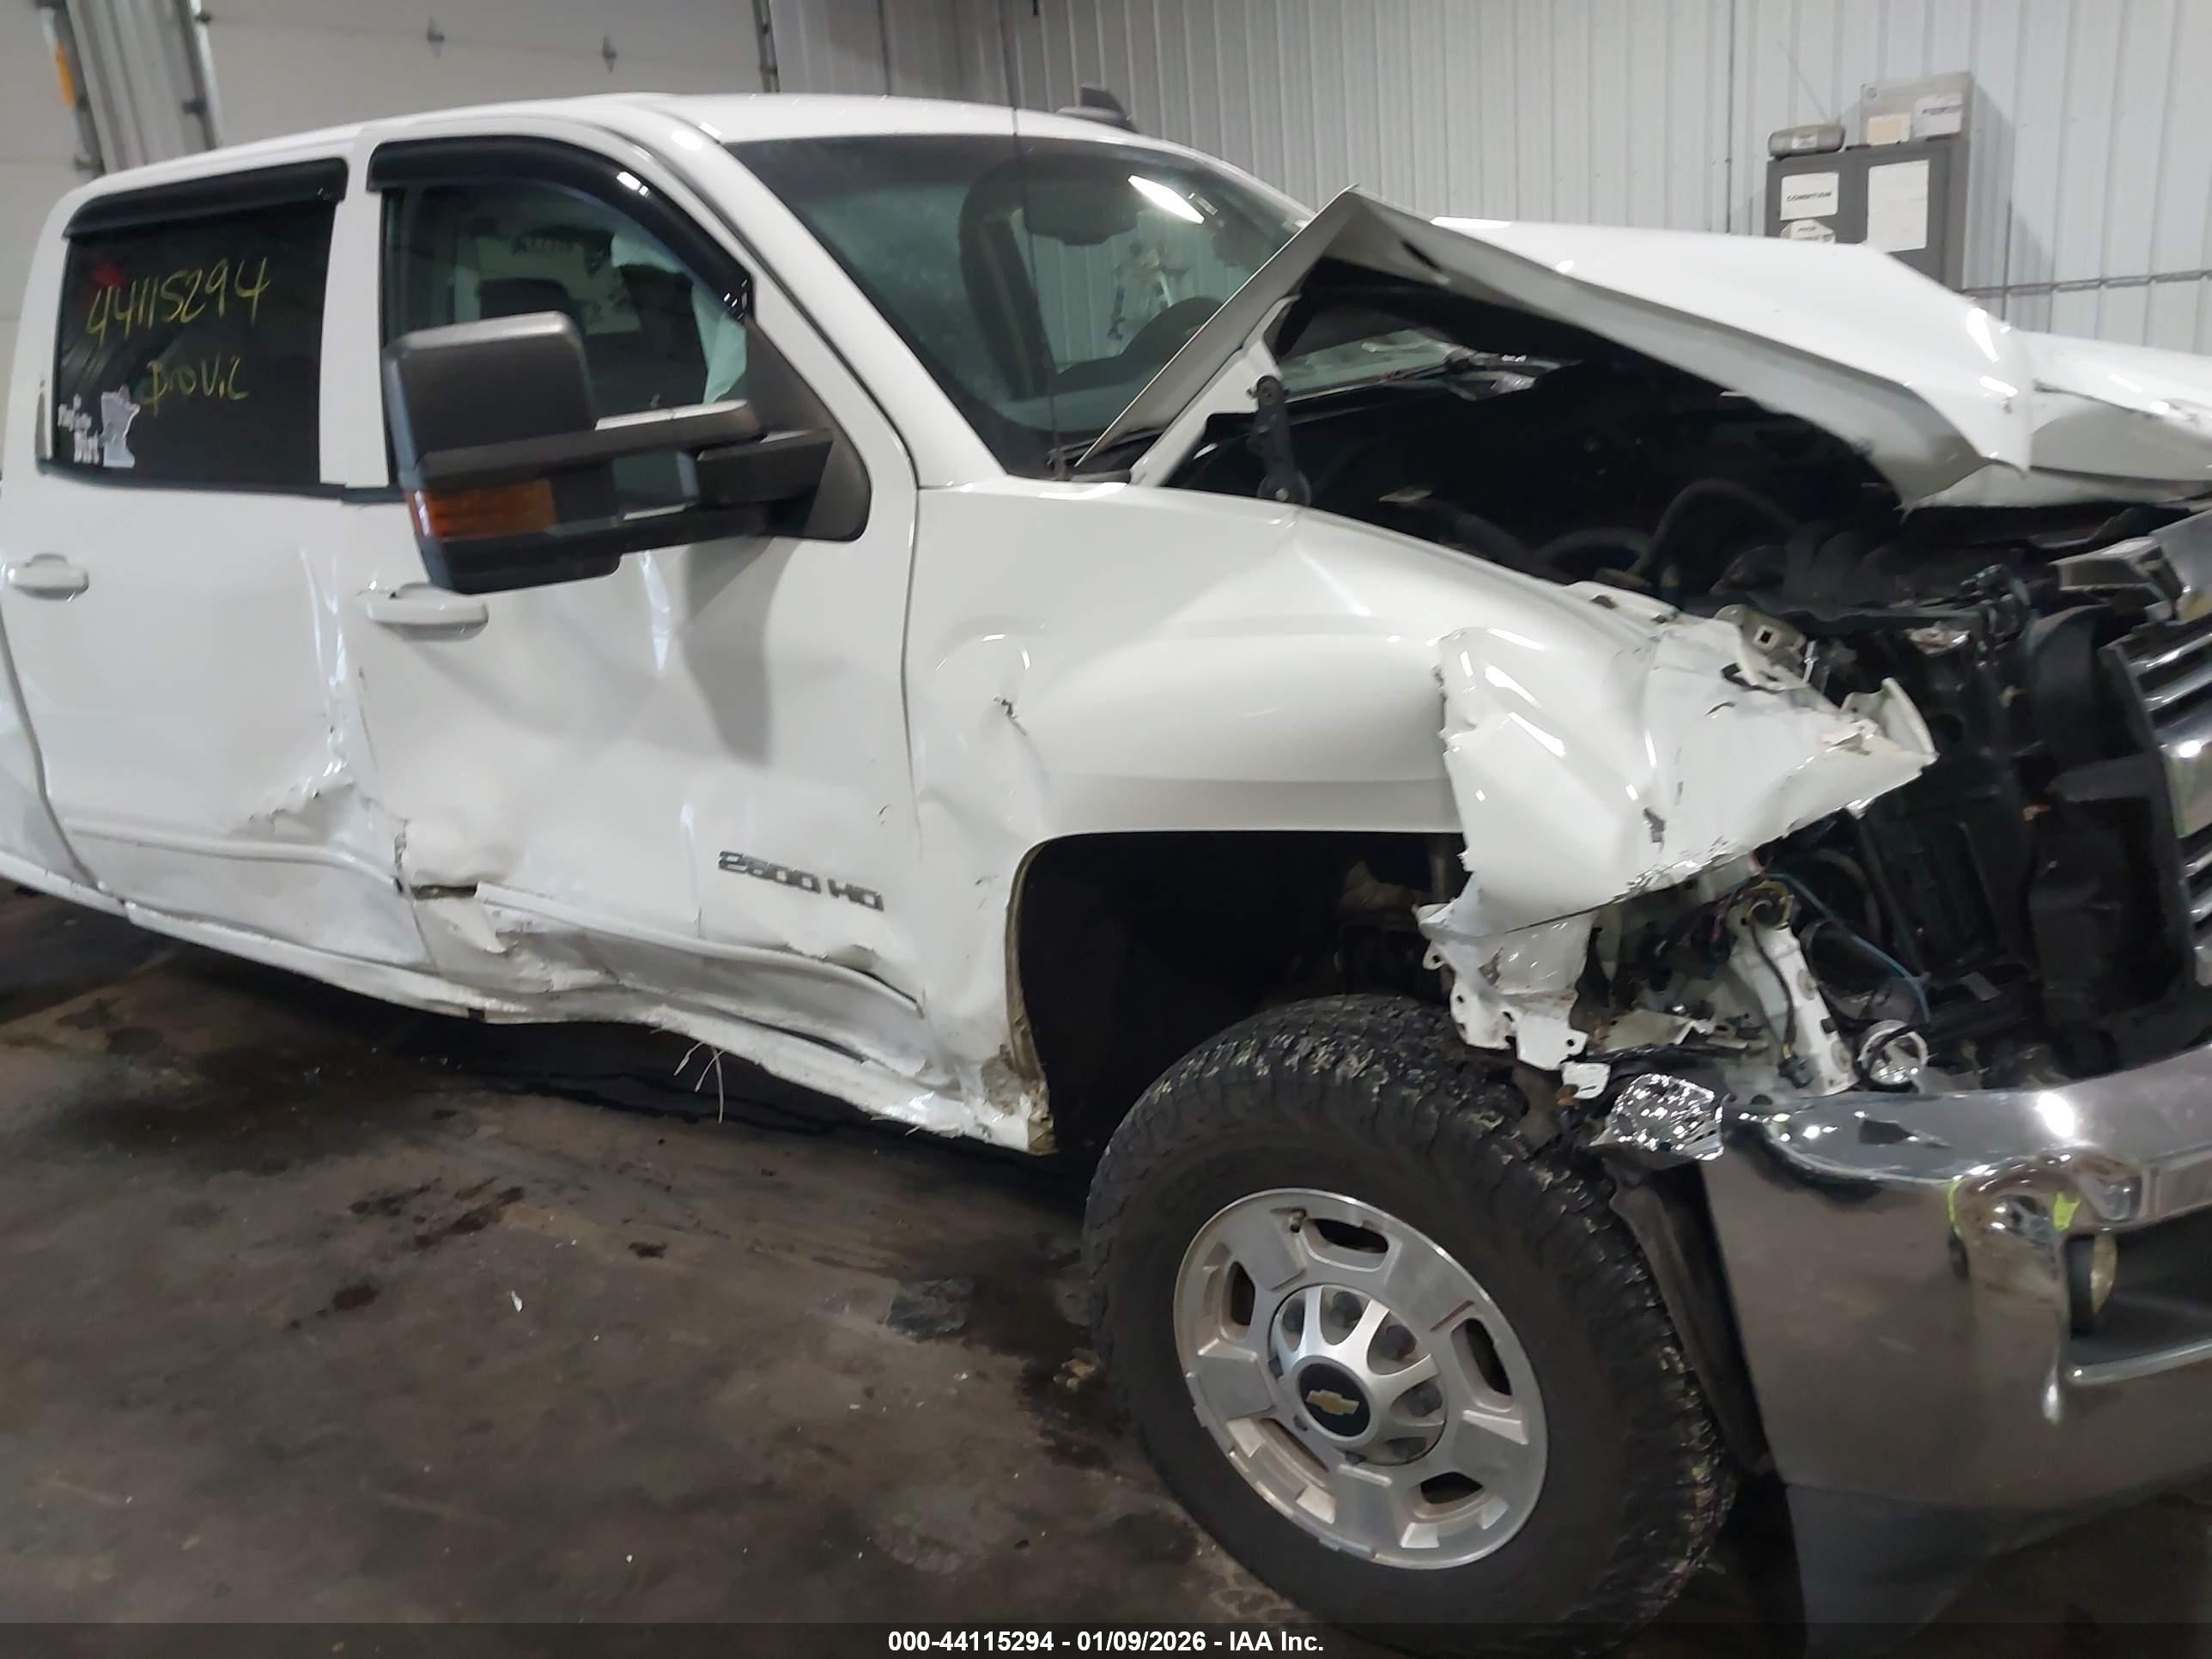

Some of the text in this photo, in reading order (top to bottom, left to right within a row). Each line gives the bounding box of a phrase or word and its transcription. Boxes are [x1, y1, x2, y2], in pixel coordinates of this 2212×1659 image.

[85, 257, 271, 344] 44115294
[718, 850, 884, 912] 2500 HD
